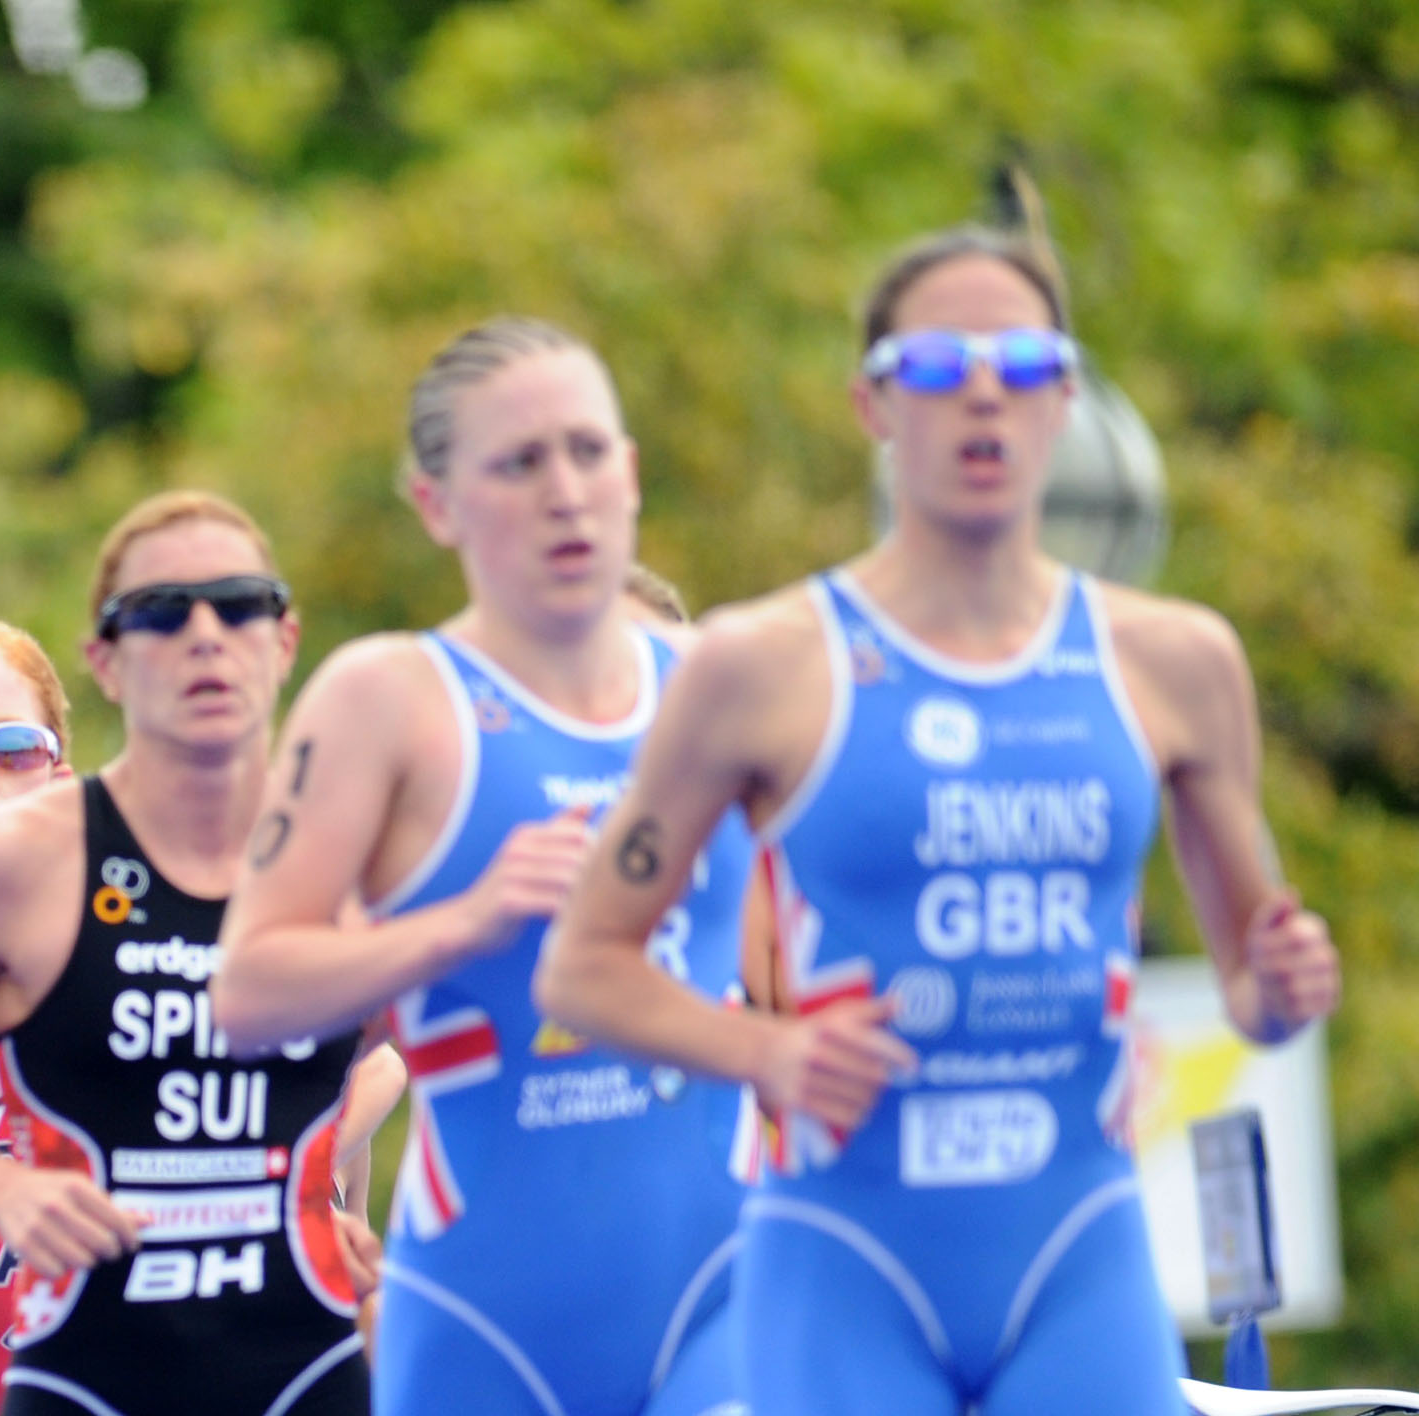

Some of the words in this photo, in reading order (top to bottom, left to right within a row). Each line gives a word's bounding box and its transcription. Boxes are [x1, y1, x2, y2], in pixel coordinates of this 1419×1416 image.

[616, 820, 660, 885] 6
[916, 870, 1095, 960] GBR
[154, 1069, 268, 1140] SUI
[123, 1242, 265, 1302] BH
